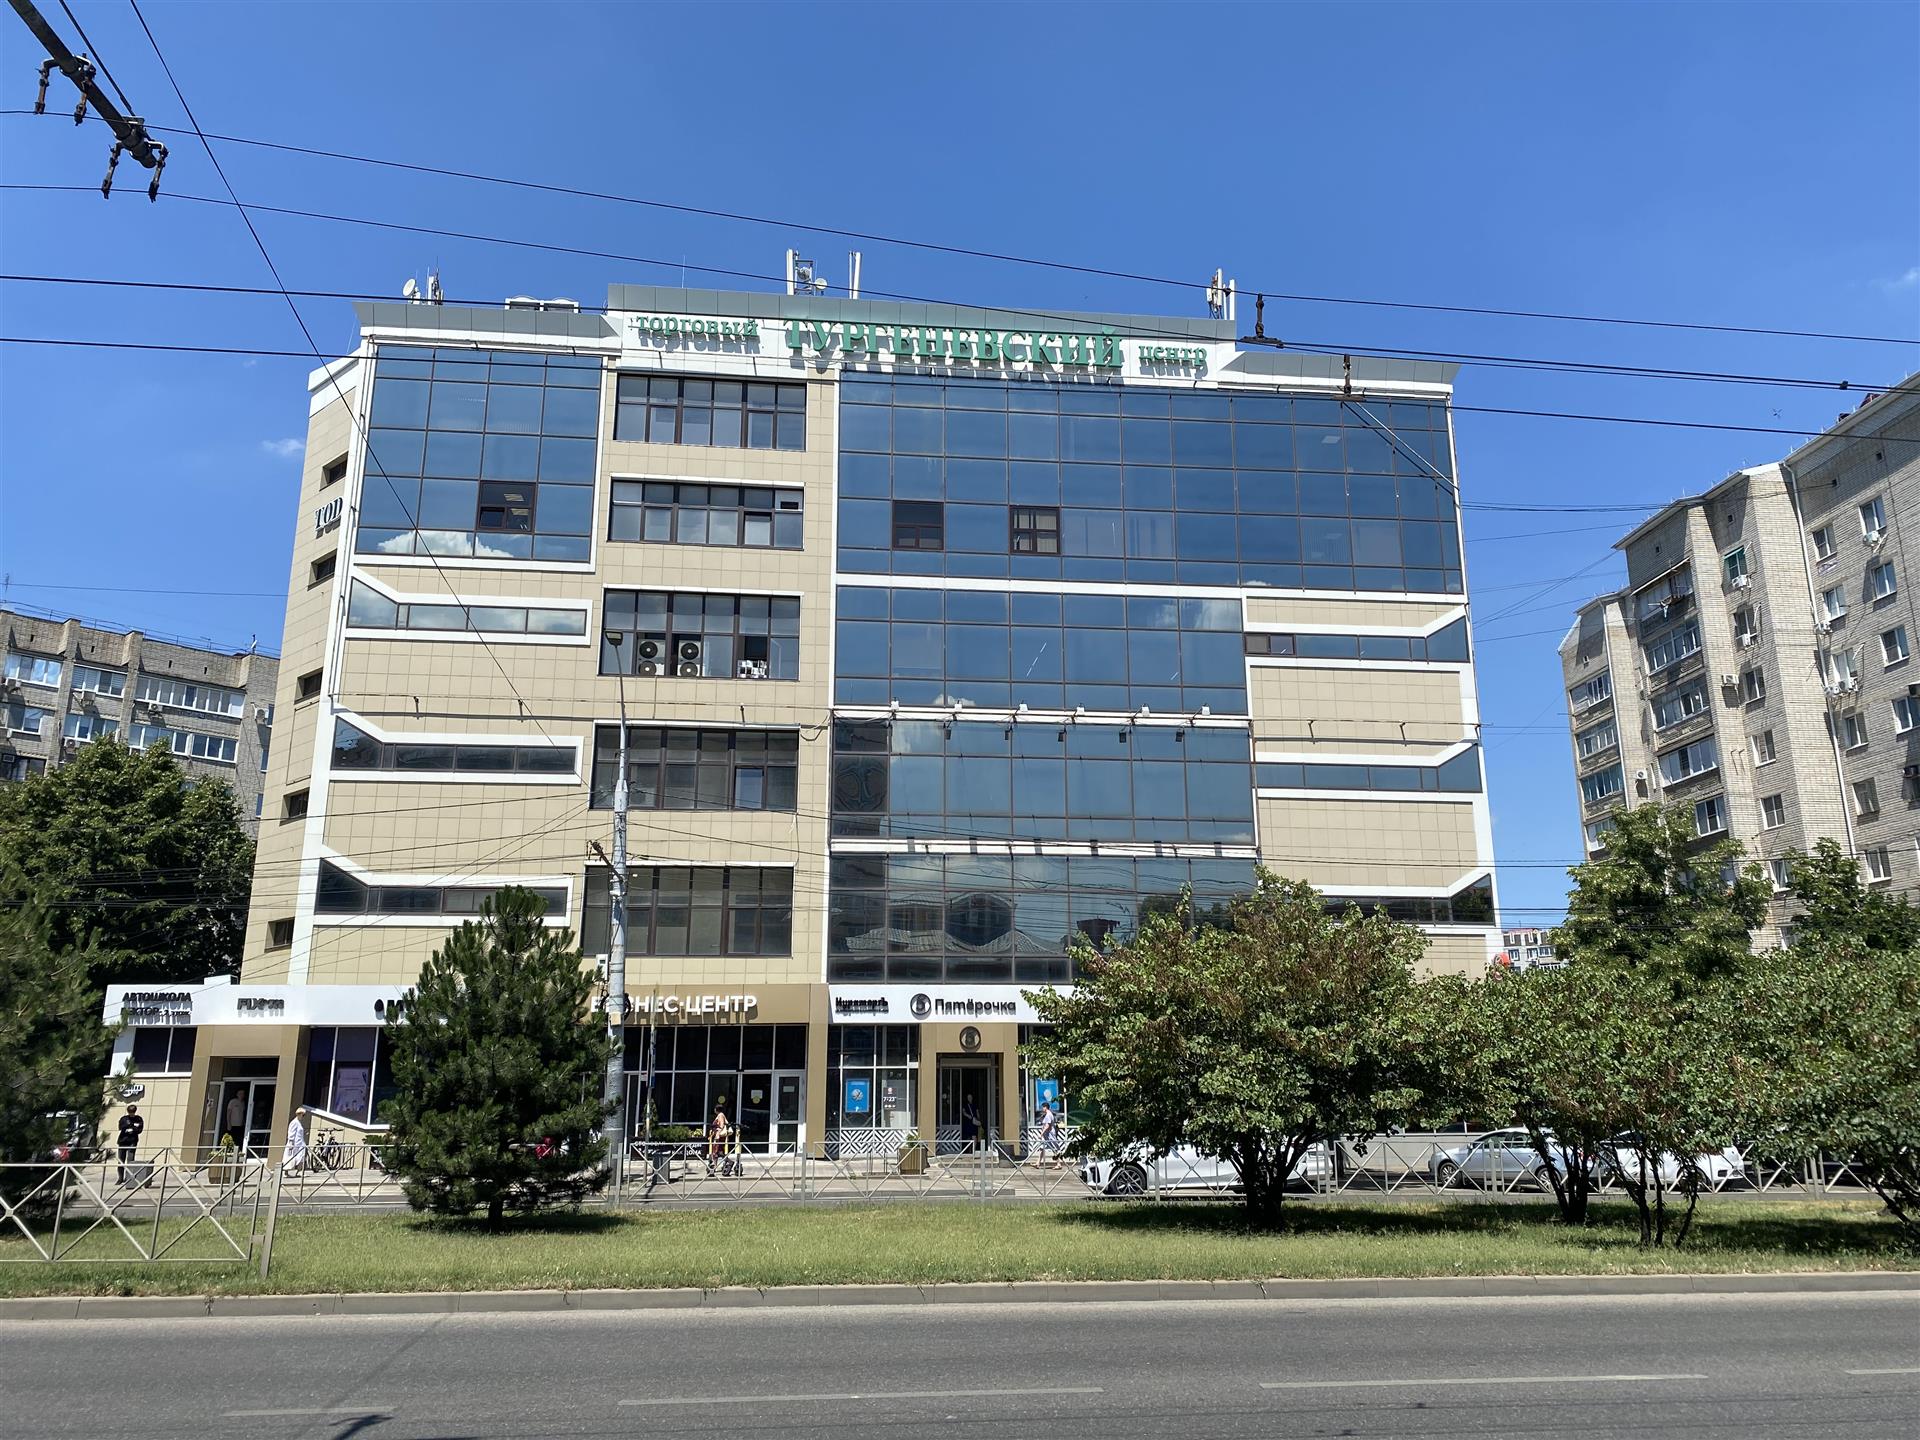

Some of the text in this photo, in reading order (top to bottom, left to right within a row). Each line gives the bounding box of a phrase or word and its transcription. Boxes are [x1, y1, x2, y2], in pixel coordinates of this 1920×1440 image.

[637, 316, 1207, 368] торговый ТУРГЕНЕВСКИЙ центр
[122, 992, 192, 1002] АВТОШКОЛА
[935, 998, 1017, 1018] Пятёрочка
